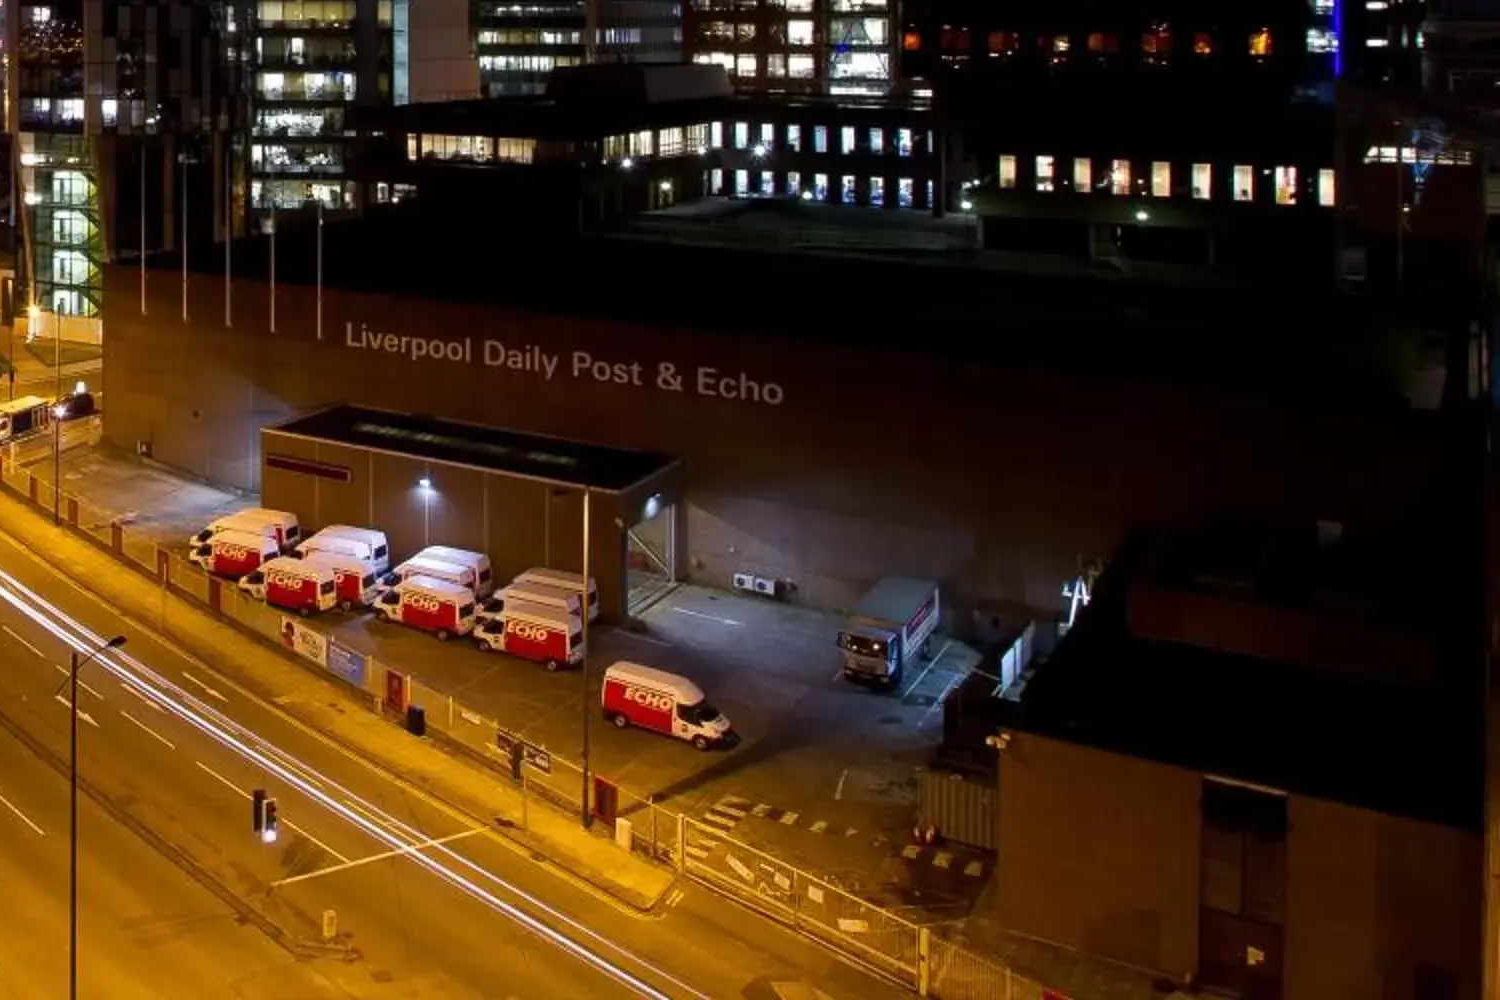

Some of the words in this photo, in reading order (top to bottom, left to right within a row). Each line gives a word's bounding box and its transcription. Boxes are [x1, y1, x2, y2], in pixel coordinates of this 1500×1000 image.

[345, 321, 471, 364] Liverpool
[483, 339, 559, 380] Daily
[572, 351, 643, 386] Post
[656, 361, 683, 392] &
[697, 366, 784, 405] Echo
[214, 542, 247, 561] ECHO
[266, 571, 302, 588] ECHO
[403, 593, 440, 611] ECHO
[507, 621, 548, 641] ECHO
[624, 687, 673, 710] ECHO
